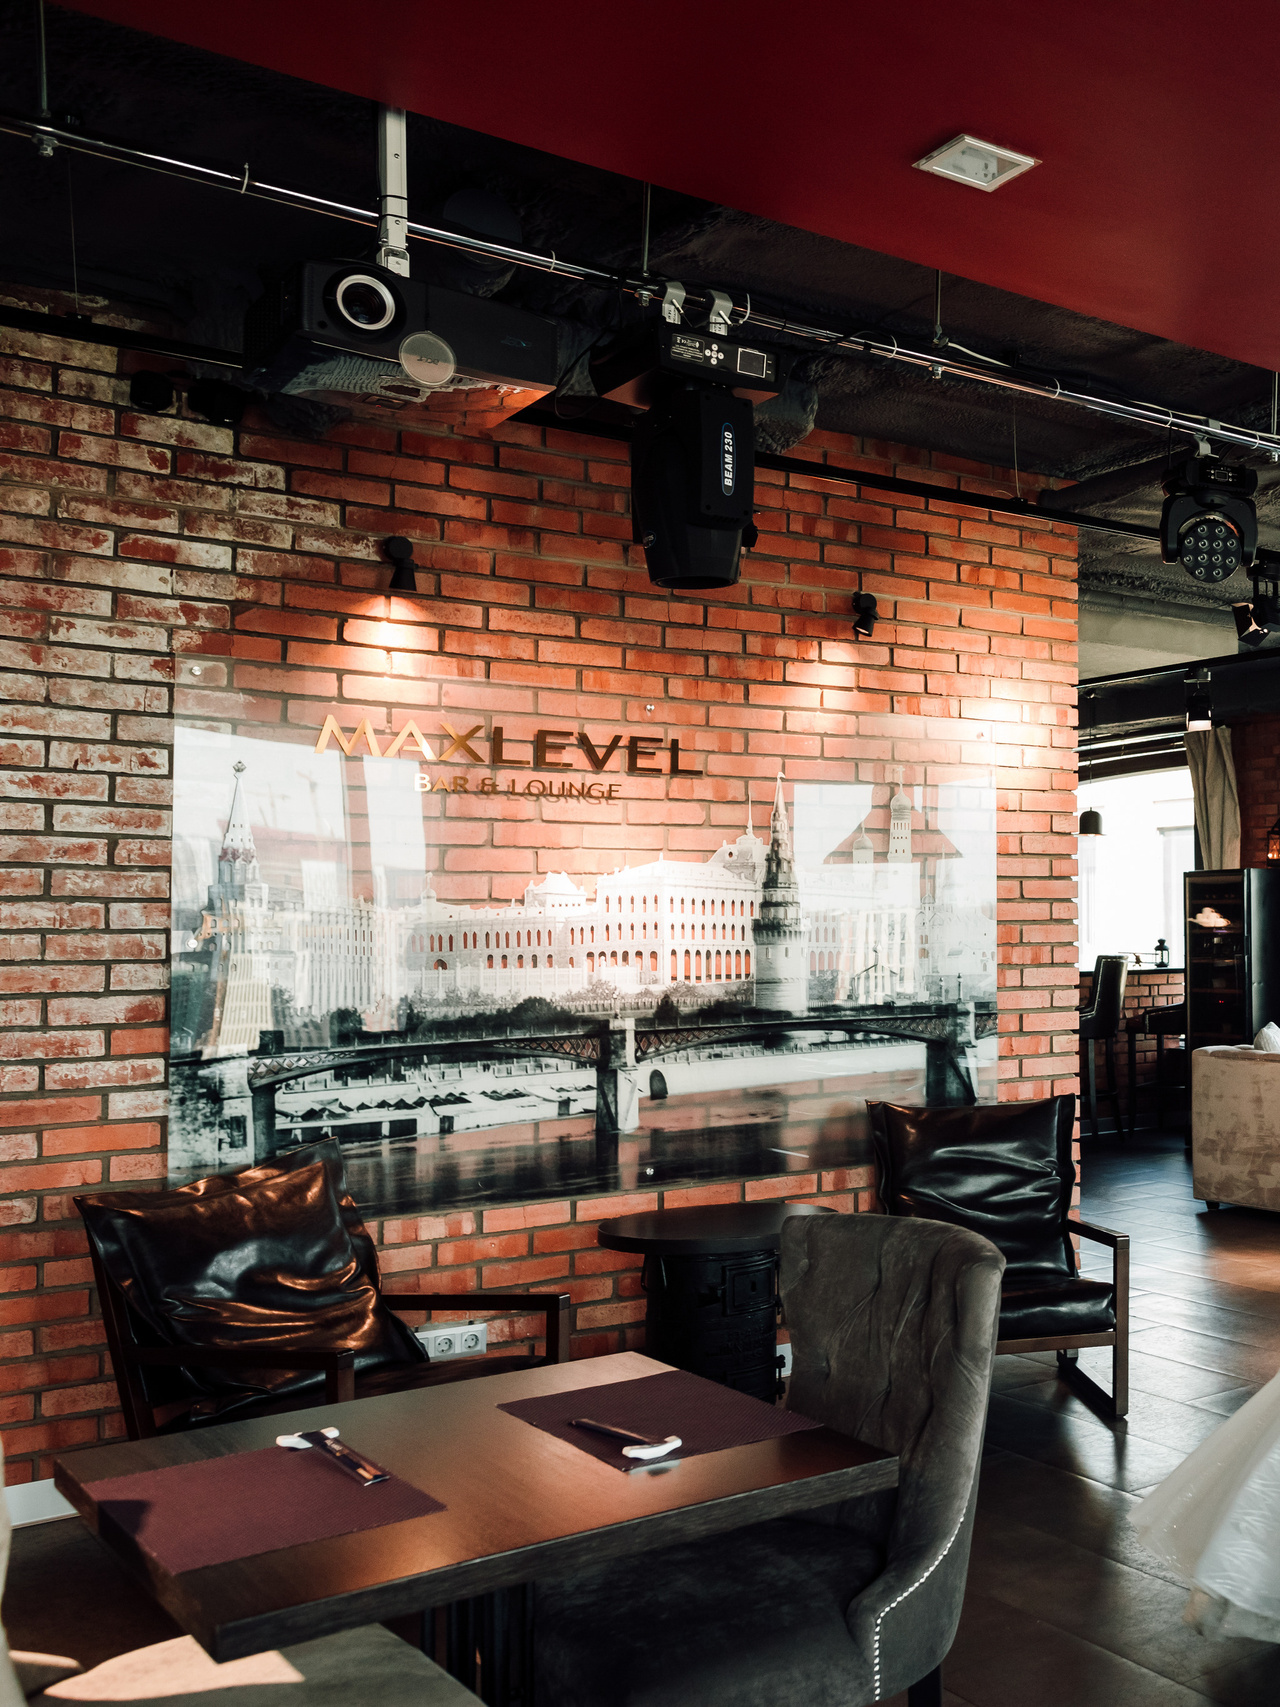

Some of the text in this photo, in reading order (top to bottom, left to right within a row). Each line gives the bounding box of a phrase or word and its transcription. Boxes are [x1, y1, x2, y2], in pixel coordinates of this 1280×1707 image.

[724, 431, 733, 486] BEAM 230
[314, 714, 704, 775] MAXLEVEL
[413, 772, 622, 799] BAR & LOUNGE
